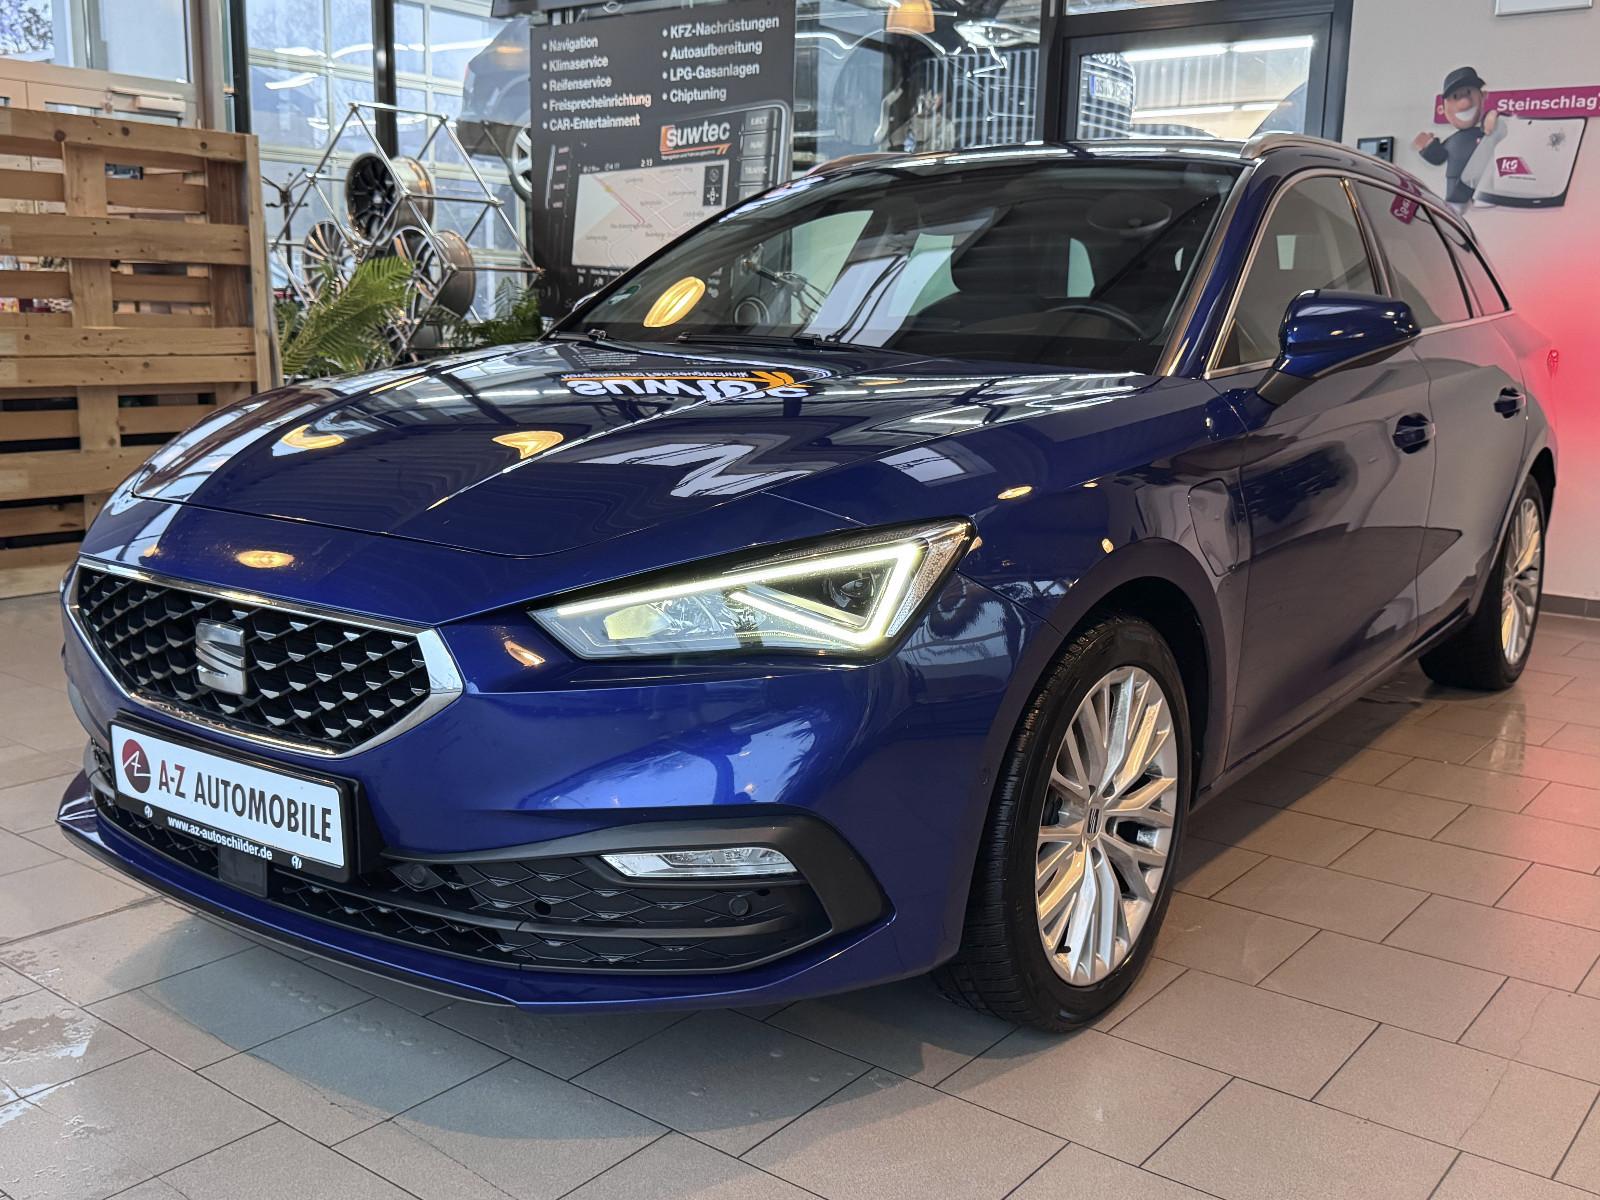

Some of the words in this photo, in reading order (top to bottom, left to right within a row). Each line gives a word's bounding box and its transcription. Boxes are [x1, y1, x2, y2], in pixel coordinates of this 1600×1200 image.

[670, 17, 779, 39] KFZ-Nachrüstungen
[549, 37, 598, 52] Navigation
[670, 41, 762, 60] Autoaufbereitung
[549, 55, 609, 72] Klimaservice
[670, 63, 760, 81] LPG-Gasanlagen
[549, 76, 612, 92] Reifenservice
[549, 93, 651, 112] Freisprecheinrichtung
[670, 86, 727, 104] Chiptuning
[549, 112, 640, 131] CAR-Entertainment
[666, 120, 731, 147] suwtec
[158, 759, 186, 799] A-Z
[194, 771, 332, 843] AUTOMOBILE
[167, 816, 272, 860] www.az-autoschilder.de
